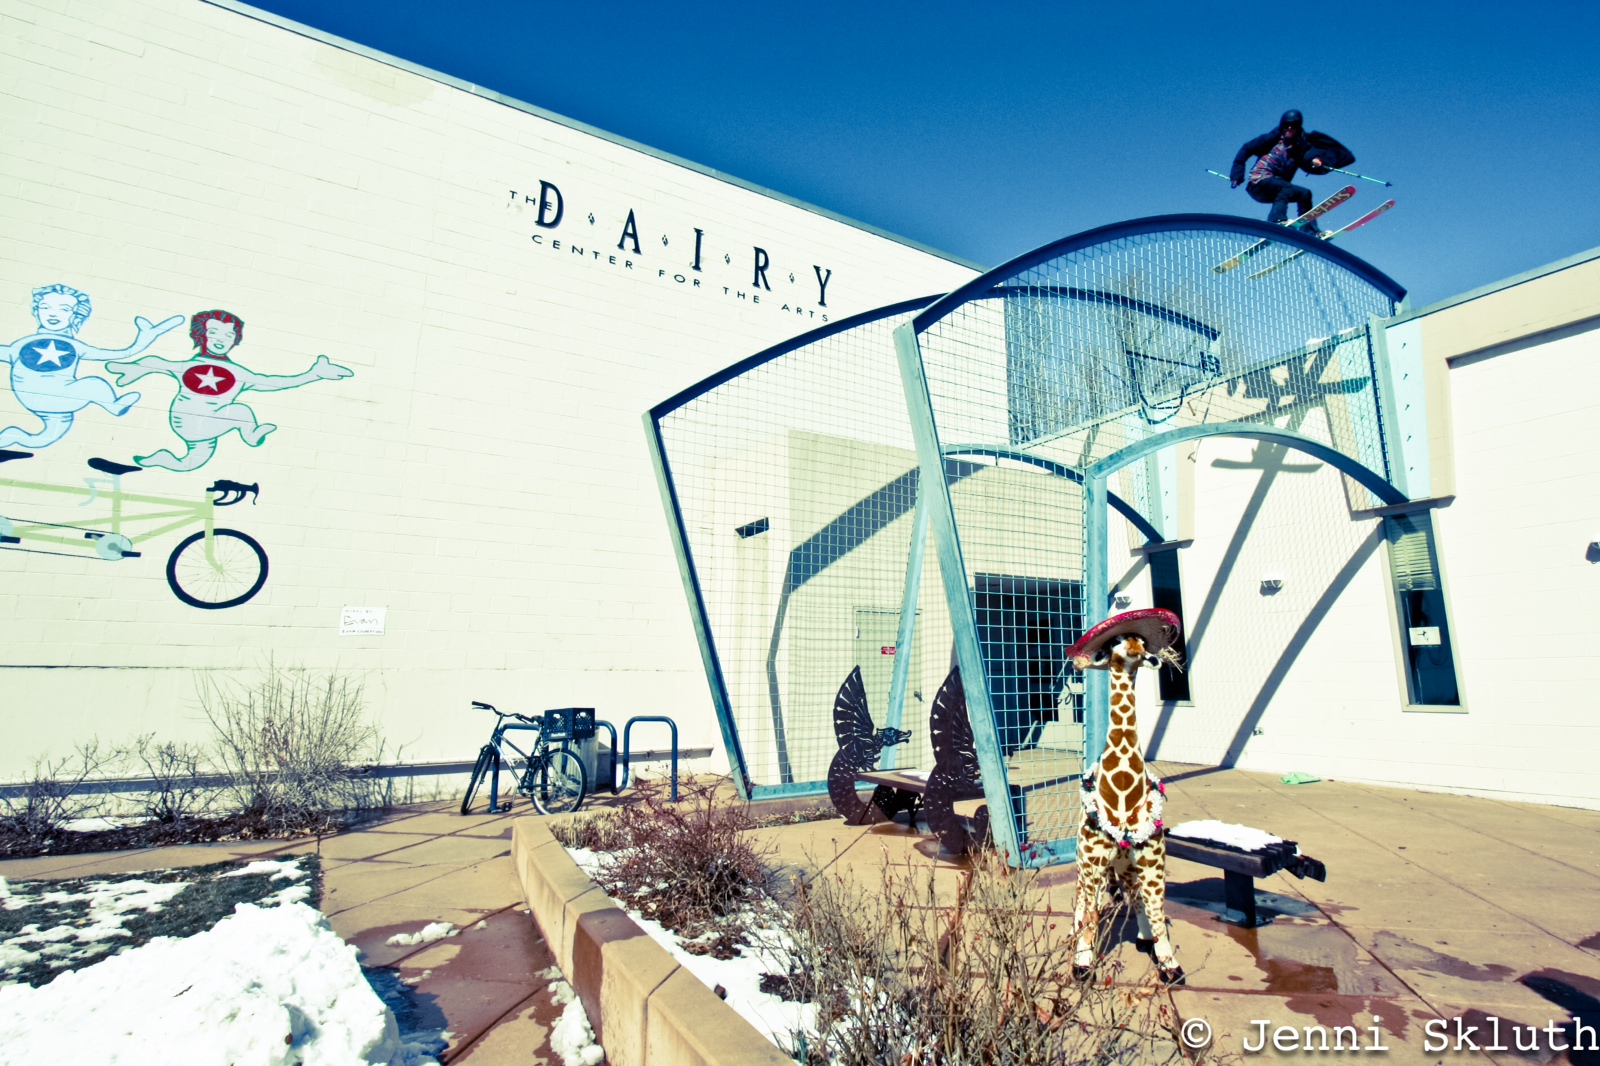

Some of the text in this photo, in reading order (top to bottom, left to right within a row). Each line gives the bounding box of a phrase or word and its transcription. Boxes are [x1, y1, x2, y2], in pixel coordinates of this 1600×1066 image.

[509, 179, 832, 307] THE DAIRY
[1300, 192, 1351, 223] Surface
[531, 234, 828, 322] CENTER FOR THE ARTS
